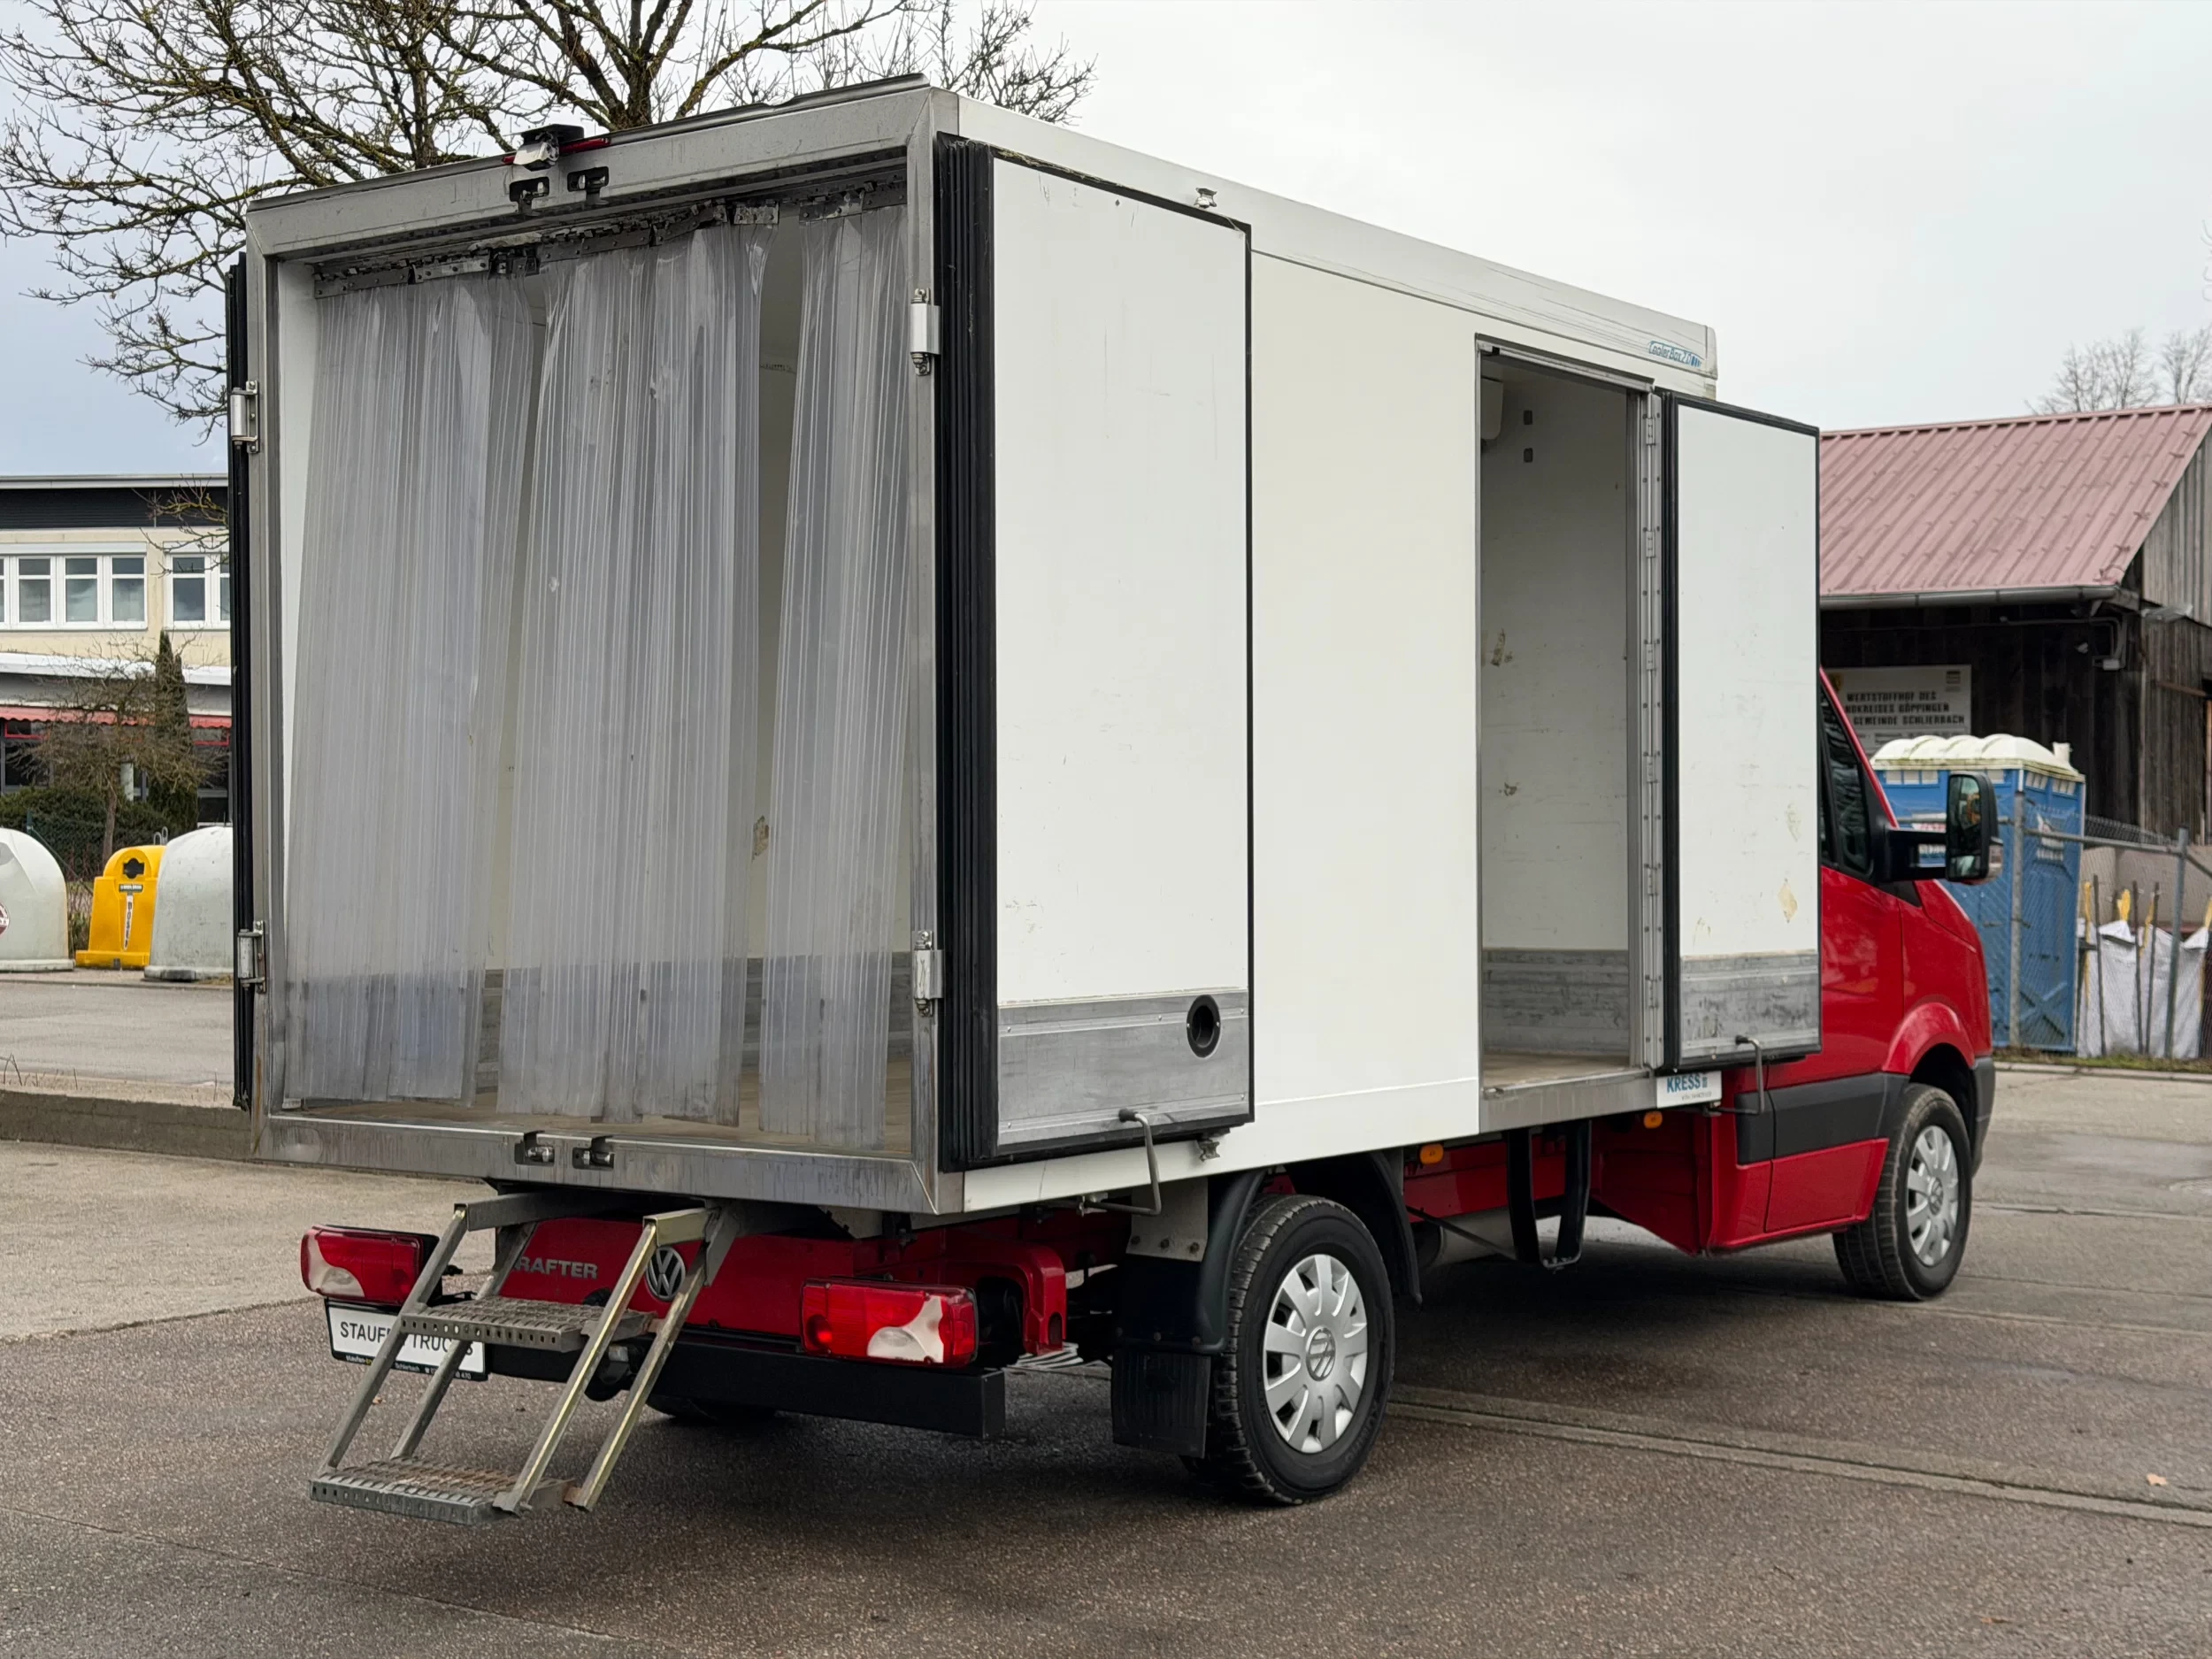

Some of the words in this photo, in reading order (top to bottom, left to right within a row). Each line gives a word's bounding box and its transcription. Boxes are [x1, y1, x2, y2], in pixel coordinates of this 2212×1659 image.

[1847, 692, 1915, 702] WERTSTOFFHOF
[1919, 691, 1937, 702] DES
[1845, 703, 1895, 714] NDKREISES
[1898, 702, 1949, 713] GÖPPINGEN
[1854, 716, 1898, 726] GEMEINDE
[1902, 715, 1965, 725] SCHLIERBACH
[1667, 1072, 1701, 1094] KRESS
[514, 1256, 598, 1279] RAFTER
[341, 1321, 391, 1343] STAUF
